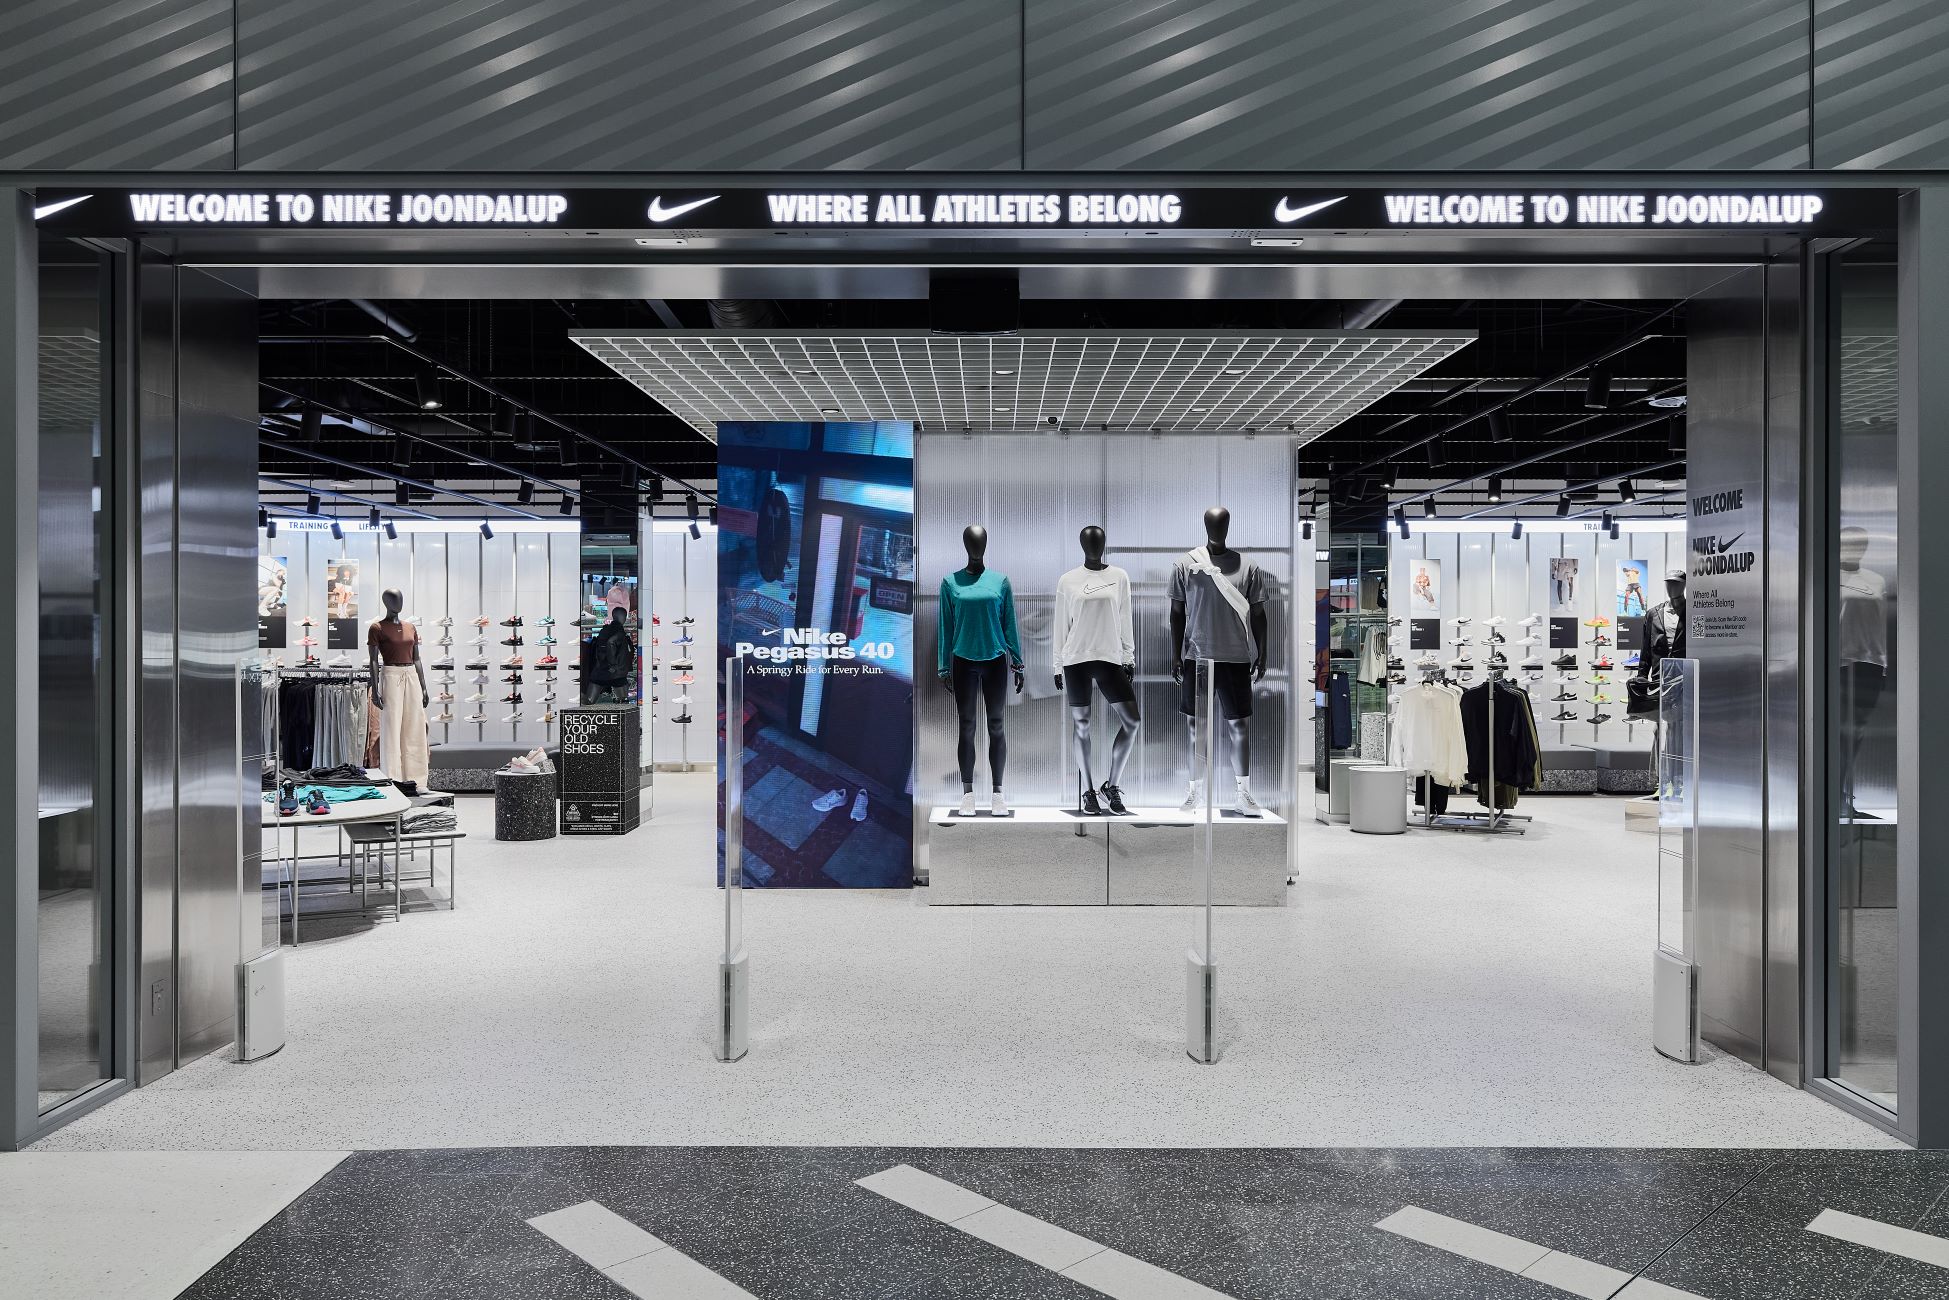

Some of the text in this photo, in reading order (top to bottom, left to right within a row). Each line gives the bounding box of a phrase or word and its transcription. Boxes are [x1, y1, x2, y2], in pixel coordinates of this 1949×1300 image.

[130, 194, 568, 222] WELCOME TO NIKE JOONDALUP
[767, 194, 1182, 223] WHERE ALL ATHLETES BELONG
[1384, 195, 1824, 223] WELCOME TO NIKE JOONDALUP
[1692, 488, 1743, 517] WELCOME
[289, 521, 329, 530] TRAINING
[1693, 535, 1716, 556] NIKE
[1693, 551, 1755, 577] JOONDALUP
[1693, 590, 1710, 599] Where
[1693, 599, 1735, 609] Athletes Belong
[783, 628, 847, 645] Nike
[735, 642, 895, 663] Pegasus 40
[746, 664, 884, 677] A Springy Ride for Every Run.
[564, 714, 618, 725] RECYCLE
[564, 724, 598, 735] YOUR
[564, 734, 589, 744] OLD
[564, 743, 605, 754] SHOES
